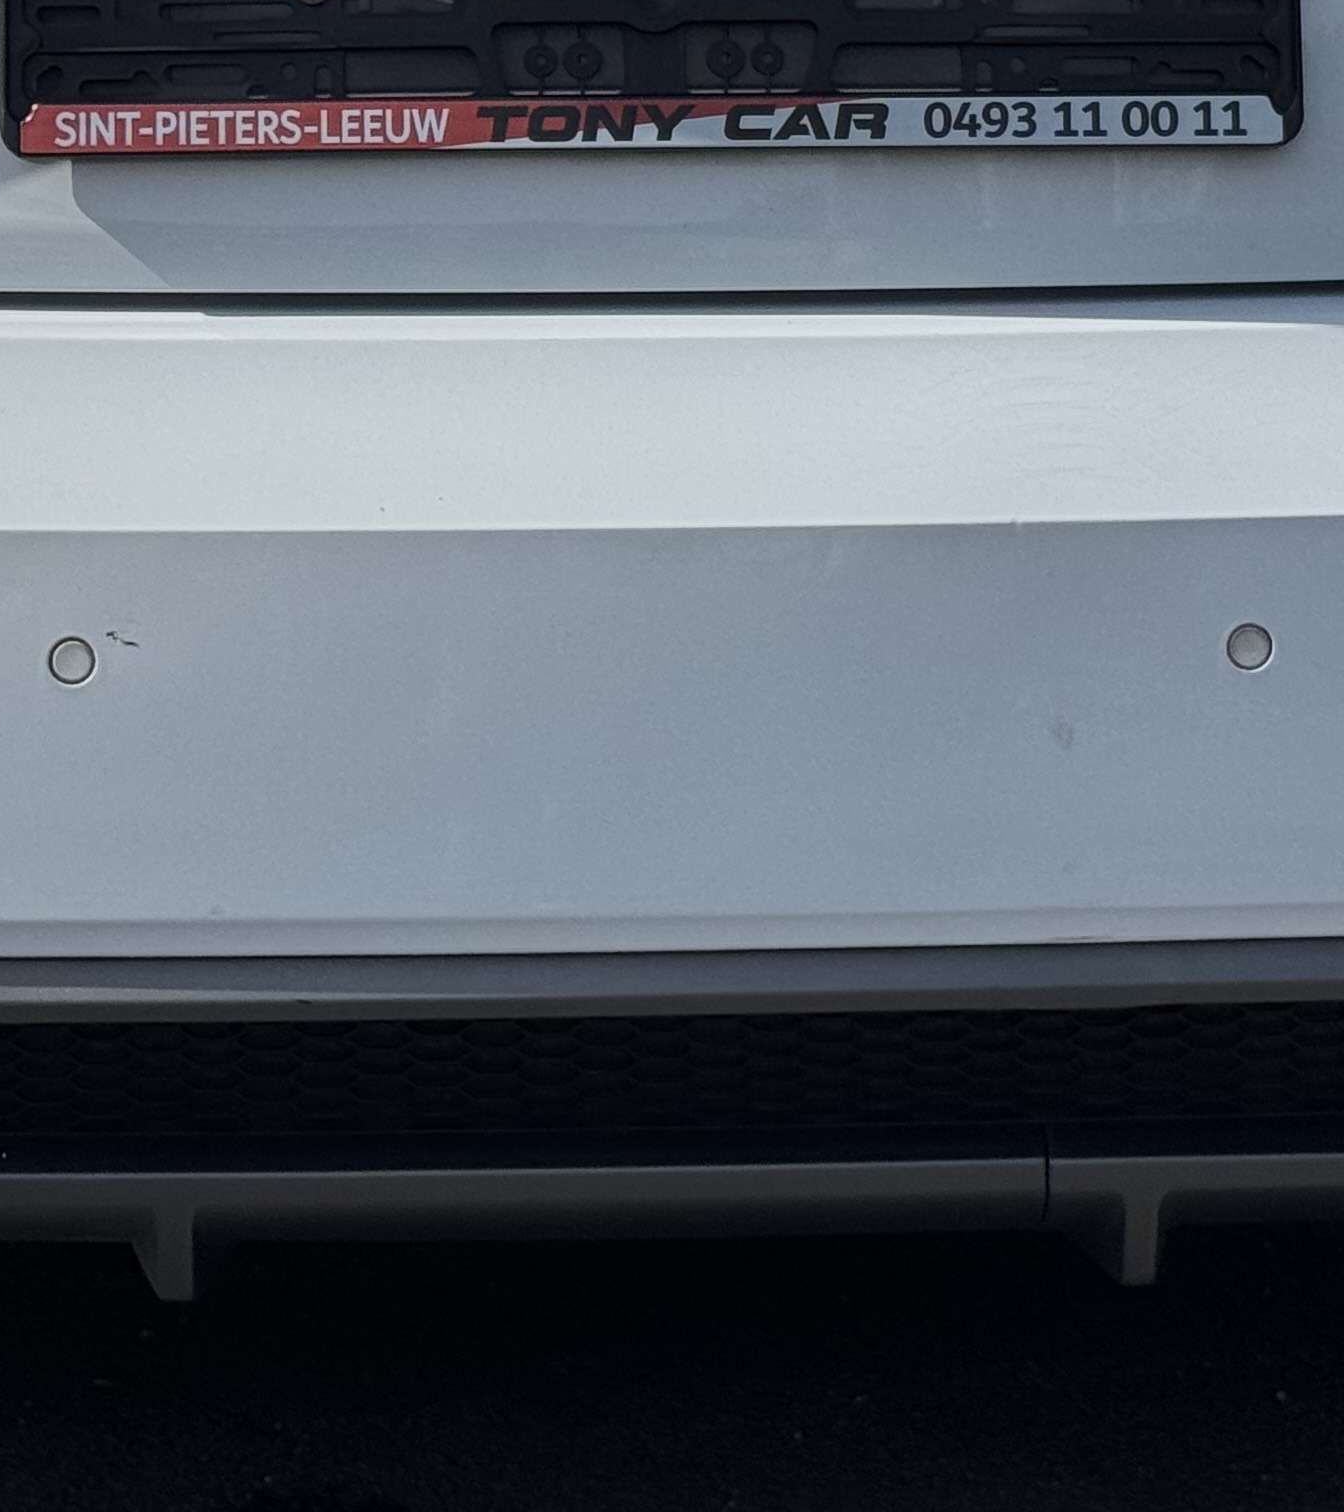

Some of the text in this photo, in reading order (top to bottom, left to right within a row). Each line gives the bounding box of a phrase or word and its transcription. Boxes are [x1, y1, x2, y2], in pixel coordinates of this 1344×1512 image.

[55, 100, 1248, 149] SINT-PIETERS-LEEUW TONY CAR 0493 11 00 11
